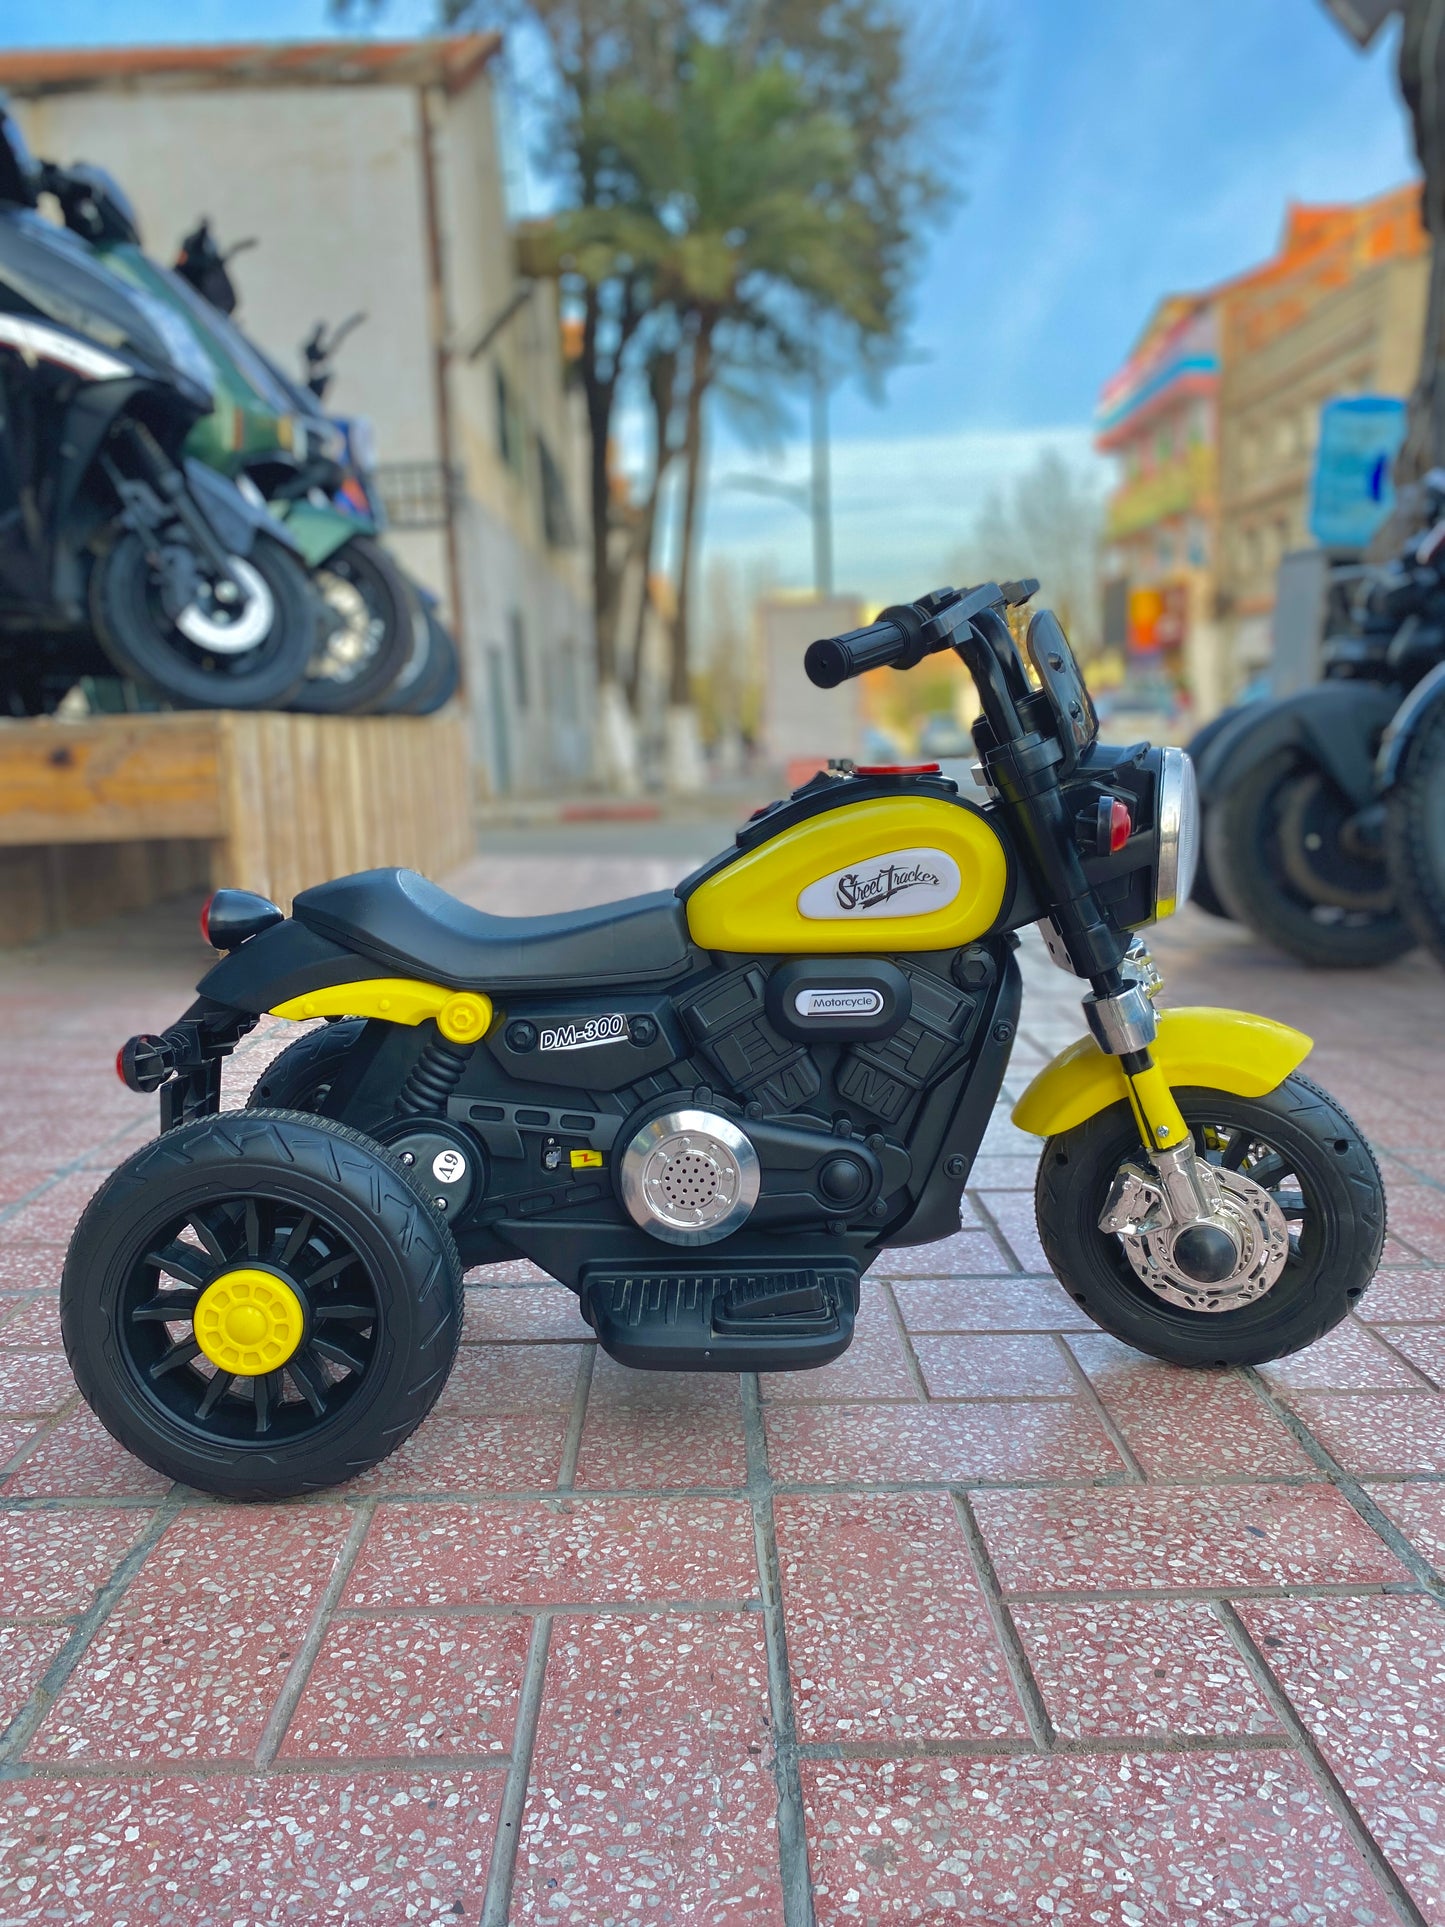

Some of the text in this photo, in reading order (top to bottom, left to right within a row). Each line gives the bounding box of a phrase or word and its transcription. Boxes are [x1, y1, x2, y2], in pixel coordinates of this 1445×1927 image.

[836, 864, 940, 910] Street Tracker
[813, 996, 873, 1008] Motorcycle
[540, 1013, 625, 1051] DM-300
[438, 1153, 459, 1181] 6V
